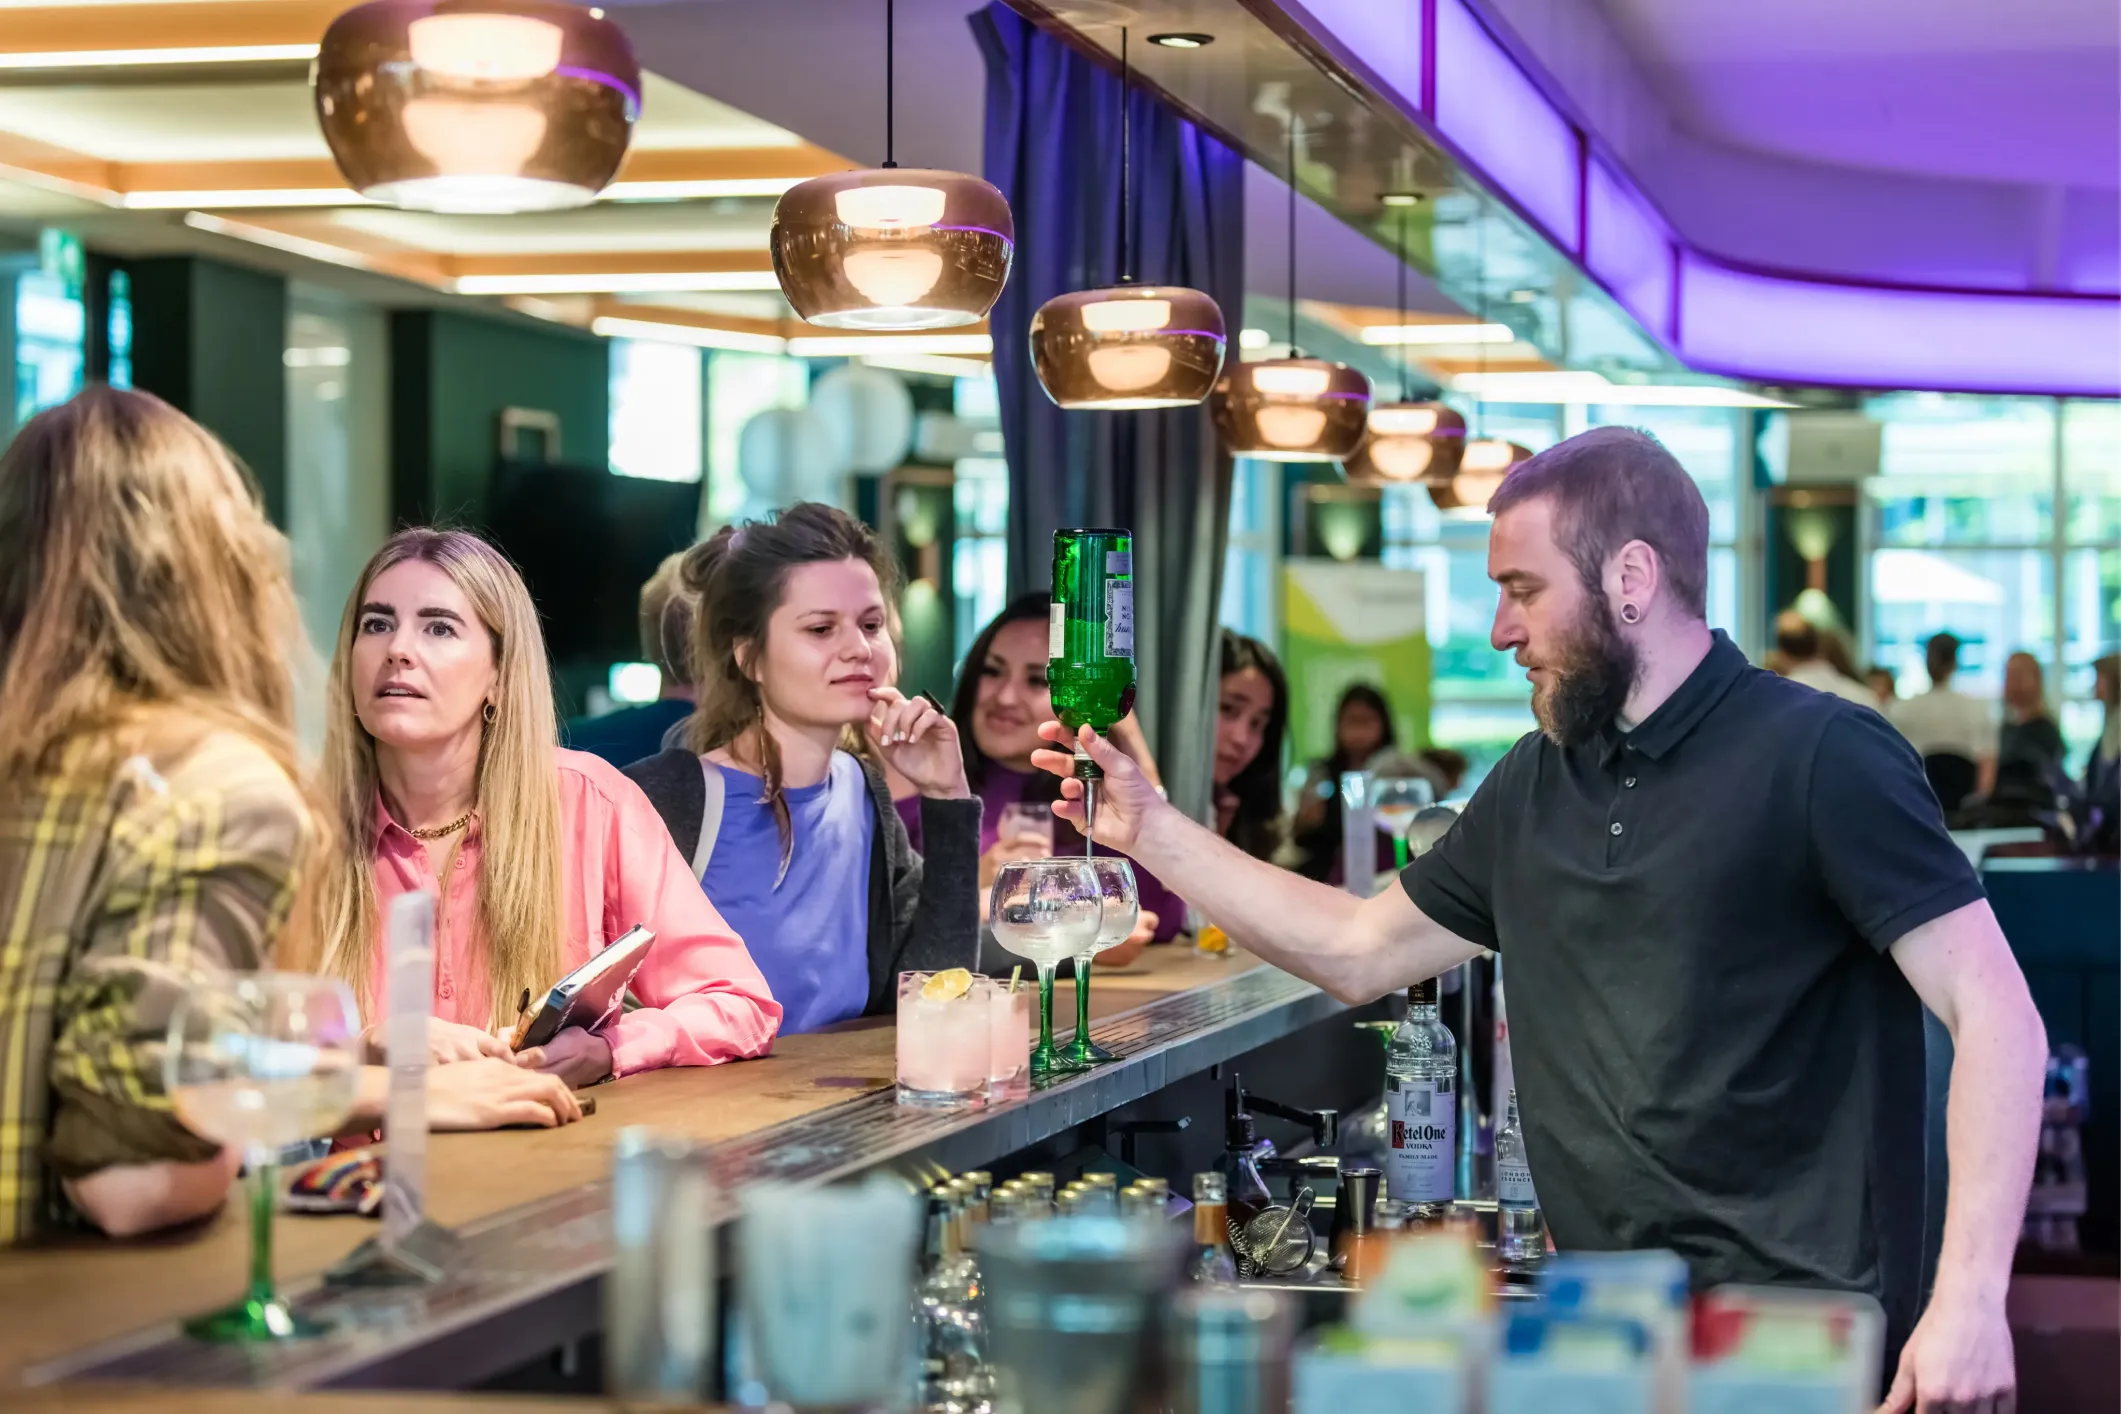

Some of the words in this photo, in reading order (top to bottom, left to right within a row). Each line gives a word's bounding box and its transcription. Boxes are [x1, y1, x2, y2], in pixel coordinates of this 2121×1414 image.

[1392, 1122, 1423, 1146] Ketel
[1424, 1124, 1446, 1141] One
[1405, 1142, 1433, 1150] VODKA
